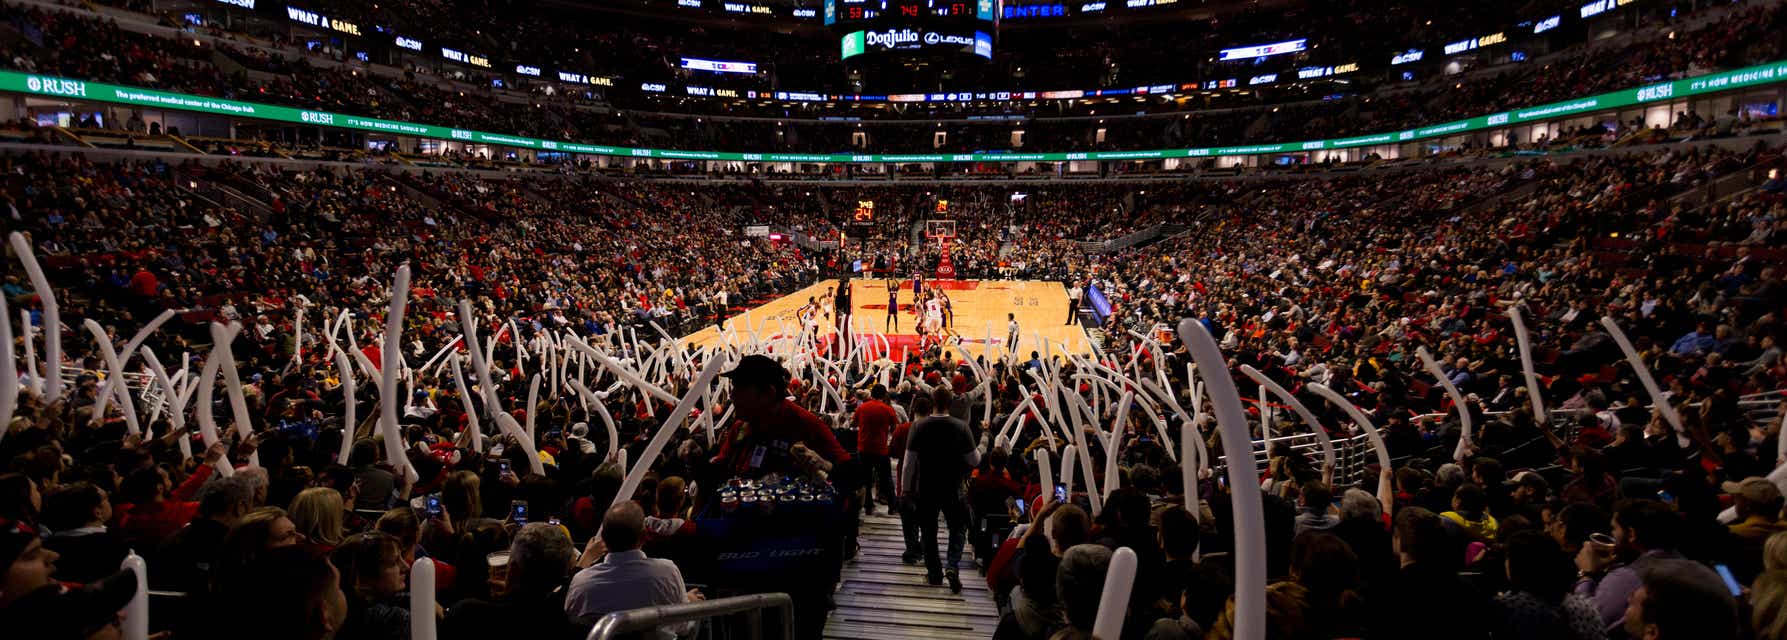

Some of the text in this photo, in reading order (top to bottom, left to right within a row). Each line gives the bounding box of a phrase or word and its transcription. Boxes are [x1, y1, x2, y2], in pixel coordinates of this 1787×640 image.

[725, 4, 744, 12] WHAT
[745, 5, 751, 13] A
[850, 8, 861, 19] 53
[952, 4, 964, 15] 57
[1004, 5, 1064, 19] ENTER
[1580, 0, 1616, 18] WHAT A
[288, 7, 361, 36] WHAT A GAME.
[1544, 15, 1560, 30] CSN
[405, 39, 422, 51] CSN
[940, 35, 974, 45] LEXUS
[1444, 32, 1507, 54] WHAT A GAME.
[442, 48, 492, 68] WHAT A GAME.
[1402, 51, 1424, 62] CSN
[525, 65, 541, 76] CSN
[1298, 63, 1359, 79] WHAT A GAME.
[559, 72, 613, 87] WHAT A GAME.
[1691, 80, 1706, 90] IT'S
[1708, 77, 1728, 87] HOW
[1731, 68, 1774, 84] MEDICINE
[43, 77, 86, 97] RUSH
[687, 86, 707, 95] WHAT
[716, 89, 739, 98] GAME.
[1645, 81, 1673, 99] RUSH
[115, 90, 128, 99] The
[310, 112, 333, 124] RUSH
[856, 208, 871, 220] 24
[718, 548, 824, 560] BUD LIGHT
